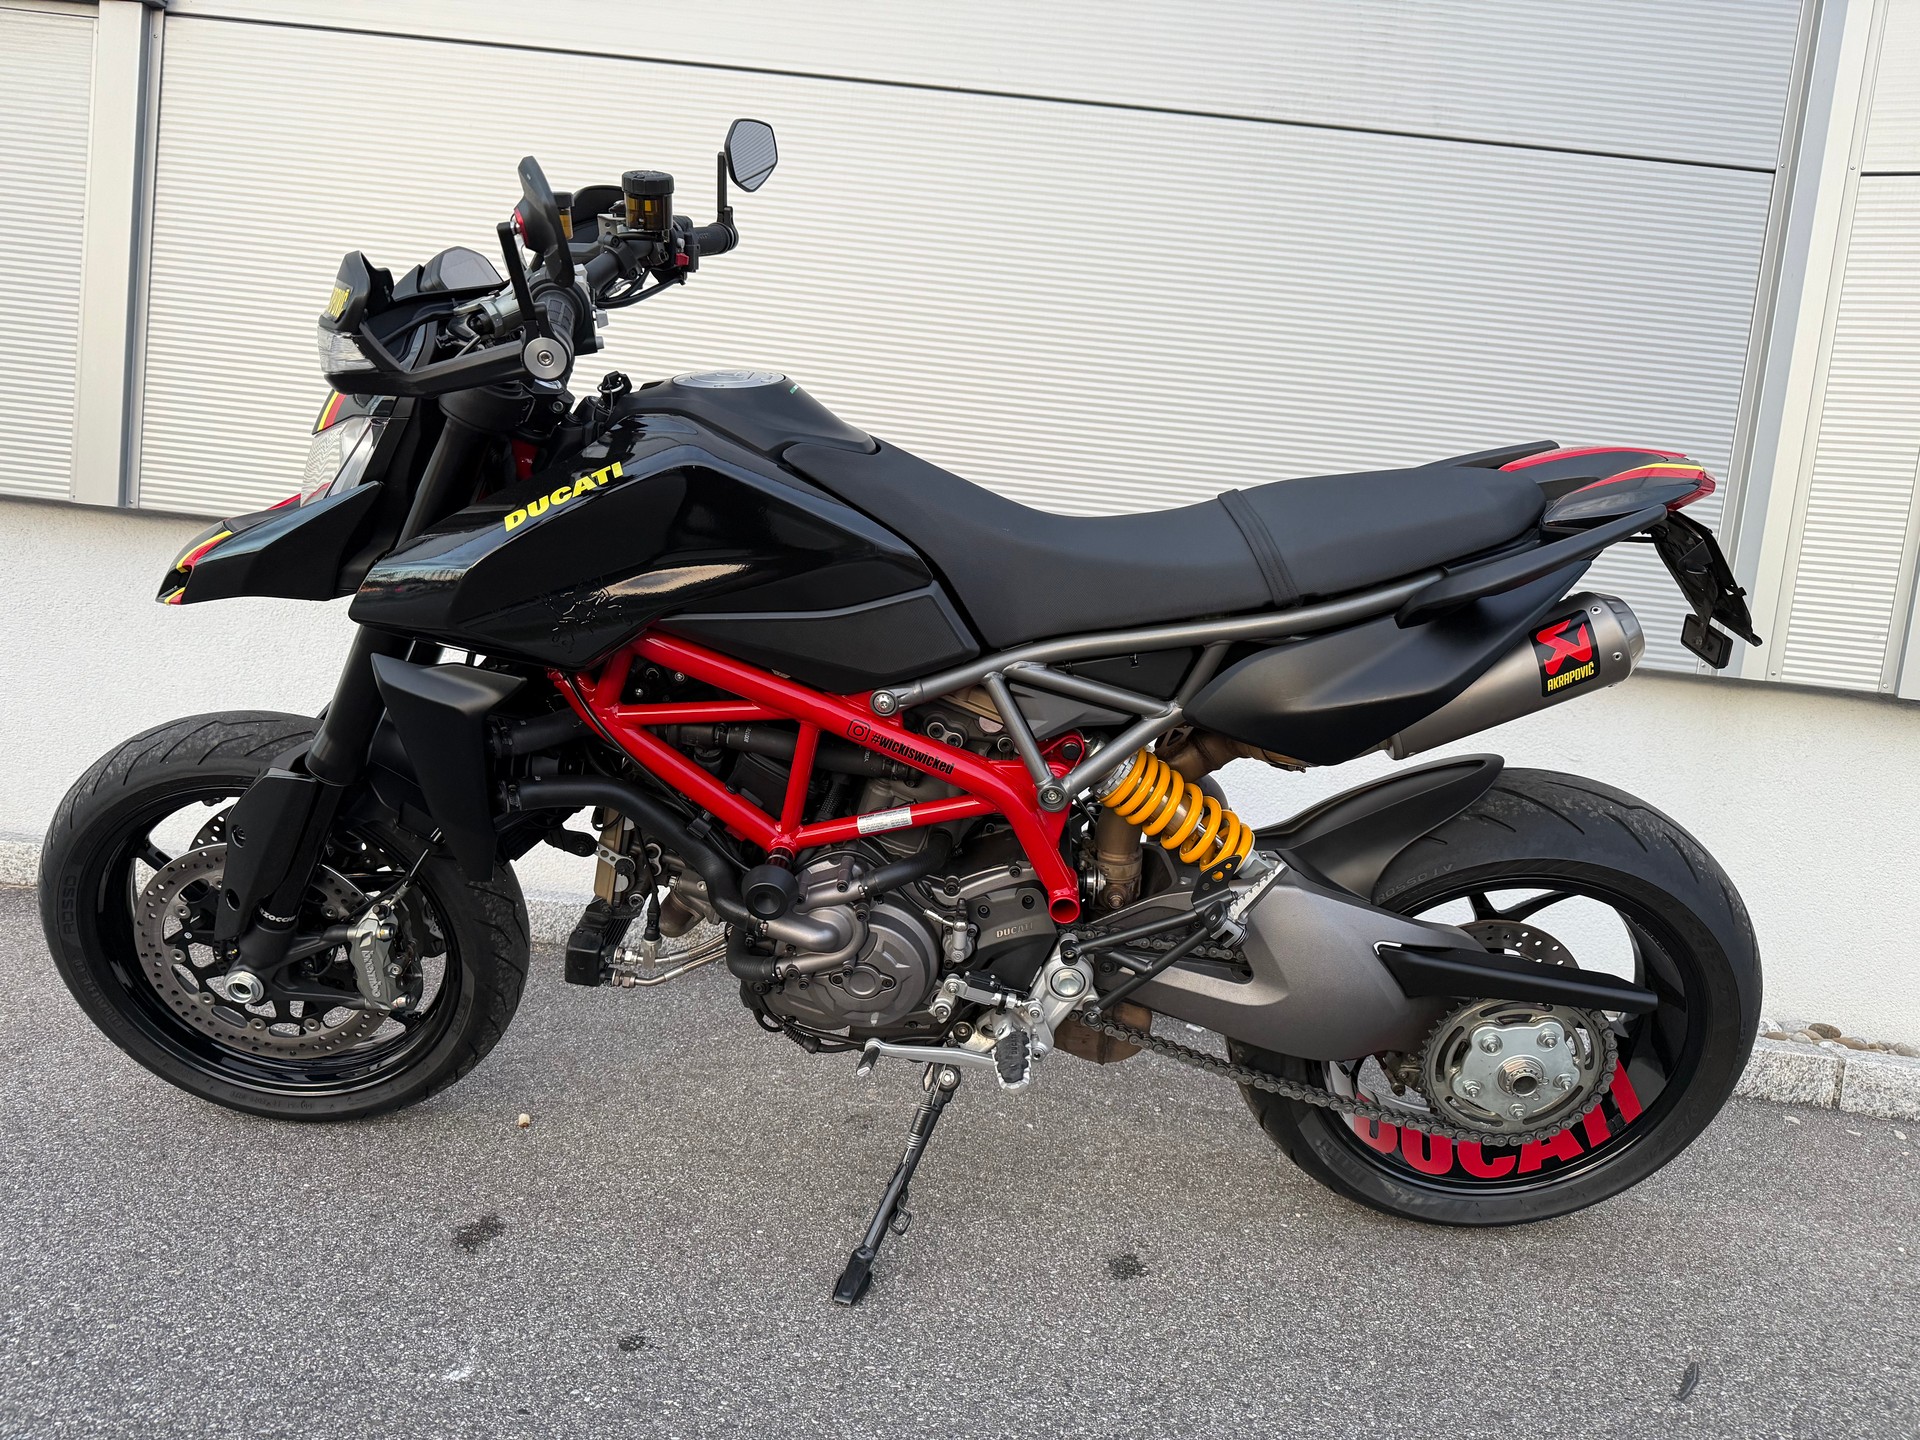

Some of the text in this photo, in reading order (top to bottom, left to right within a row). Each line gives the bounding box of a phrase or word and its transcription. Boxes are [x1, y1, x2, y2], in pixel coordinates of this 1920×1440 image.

[503, 461, 624, 532] DUCATI
[871, 732, 955, 774] #wickiswicked
[62, 875, 77, 935] ROSSO
[1375, 872, 1428, 904] ROSSO
[996, 922, 1033, 938] DUCATI
[361, 950, 381, 998] brembo
